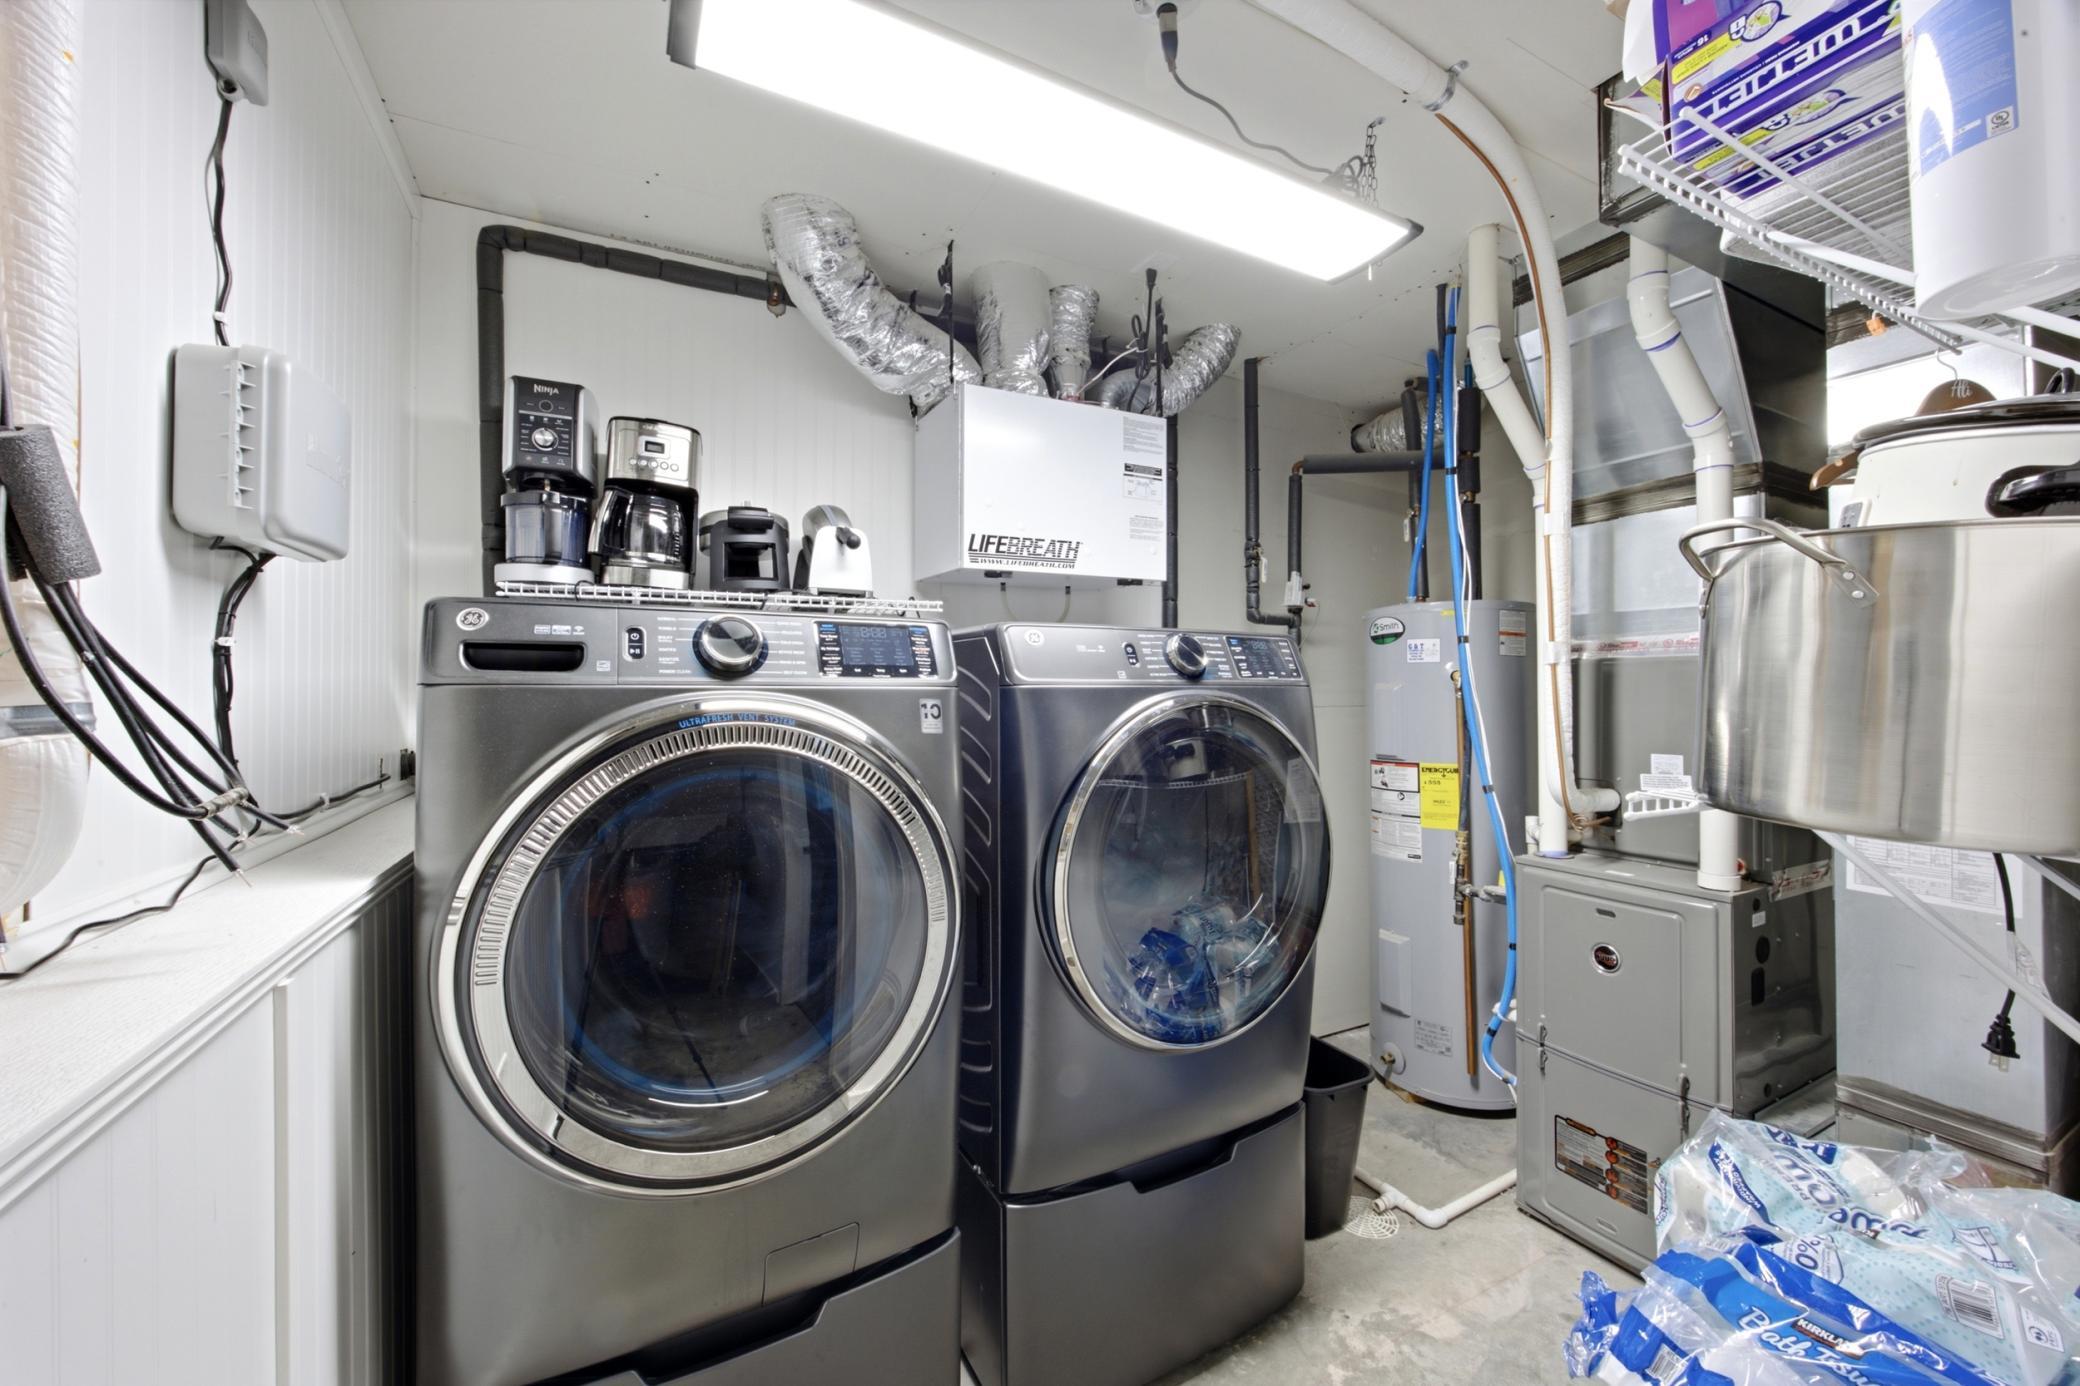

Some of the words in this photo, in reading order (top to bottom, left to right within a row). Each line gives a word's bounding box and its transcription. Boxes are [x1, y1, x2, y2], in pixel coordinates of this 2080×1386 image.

[533, 383, 560, 396] NINJA
[968, 533, 1081, 558] LIFEBREATH
[679, 713, 733, 728] ULTRAFRESH
[738, 712, 759, 722] VENT
[764, 715, 796, 727] SYSTEM
[1738, 1306, 1811, 1356] Bath
[1797, 1318, 1850, 1350] KIRKLA
